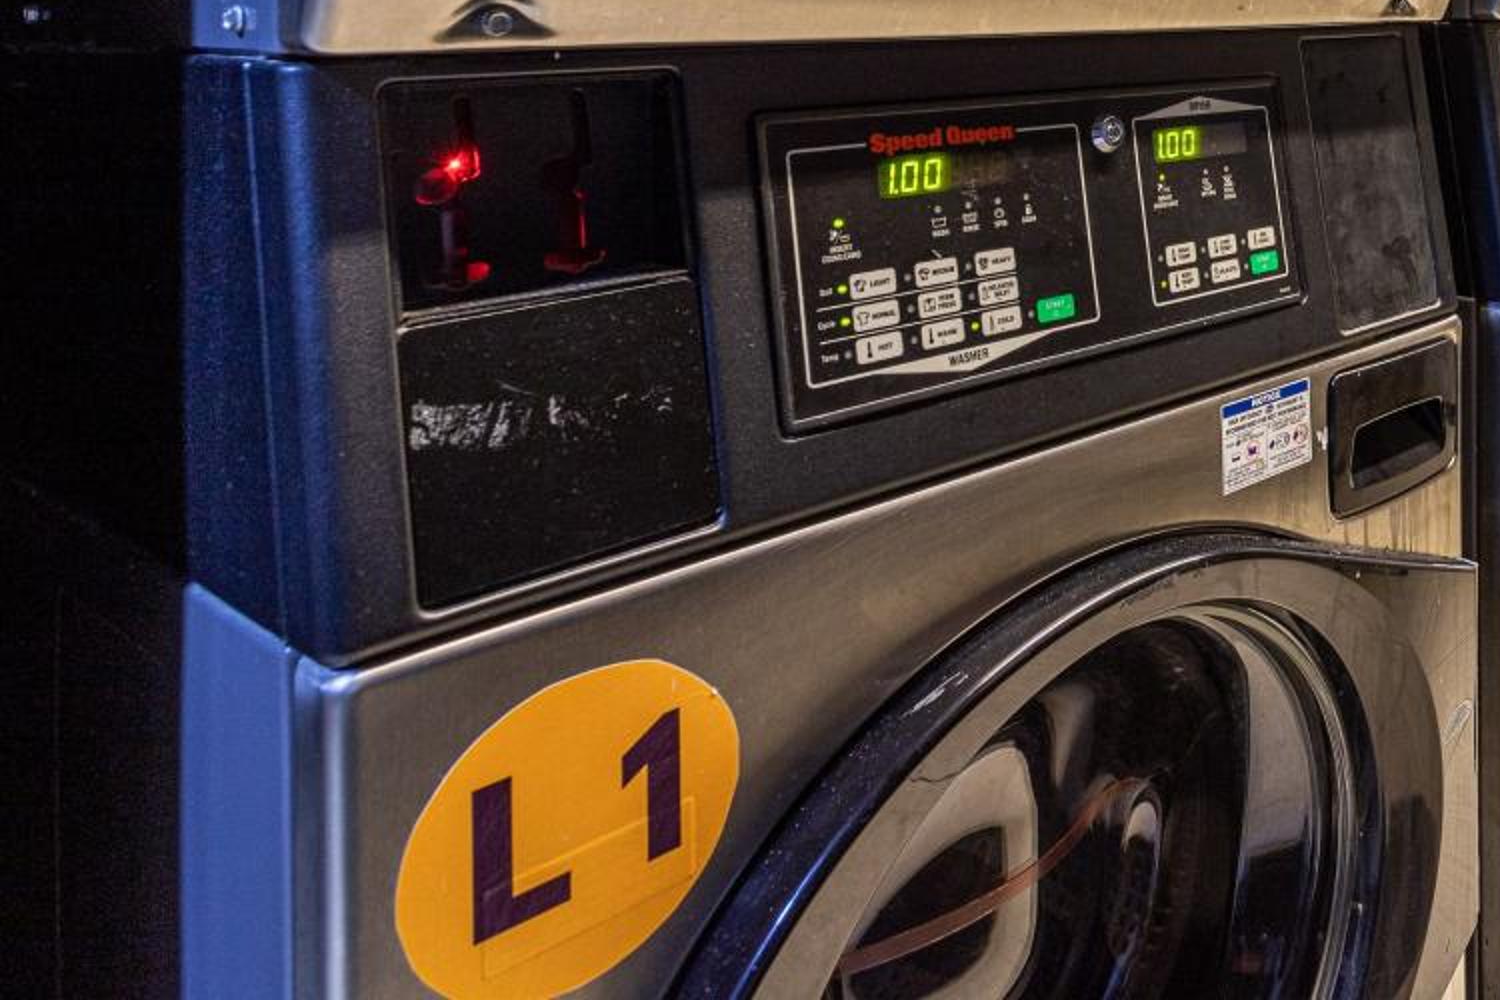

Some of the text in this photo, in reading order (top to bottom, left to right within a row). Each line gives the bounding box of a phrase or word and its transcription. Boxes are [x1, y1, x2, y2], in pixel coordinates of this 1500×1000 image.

[869, 124, 1016, 159] Speed Queen
[948, 348, 990, 367] WASHER
[471, 706, 683, 947] L1
